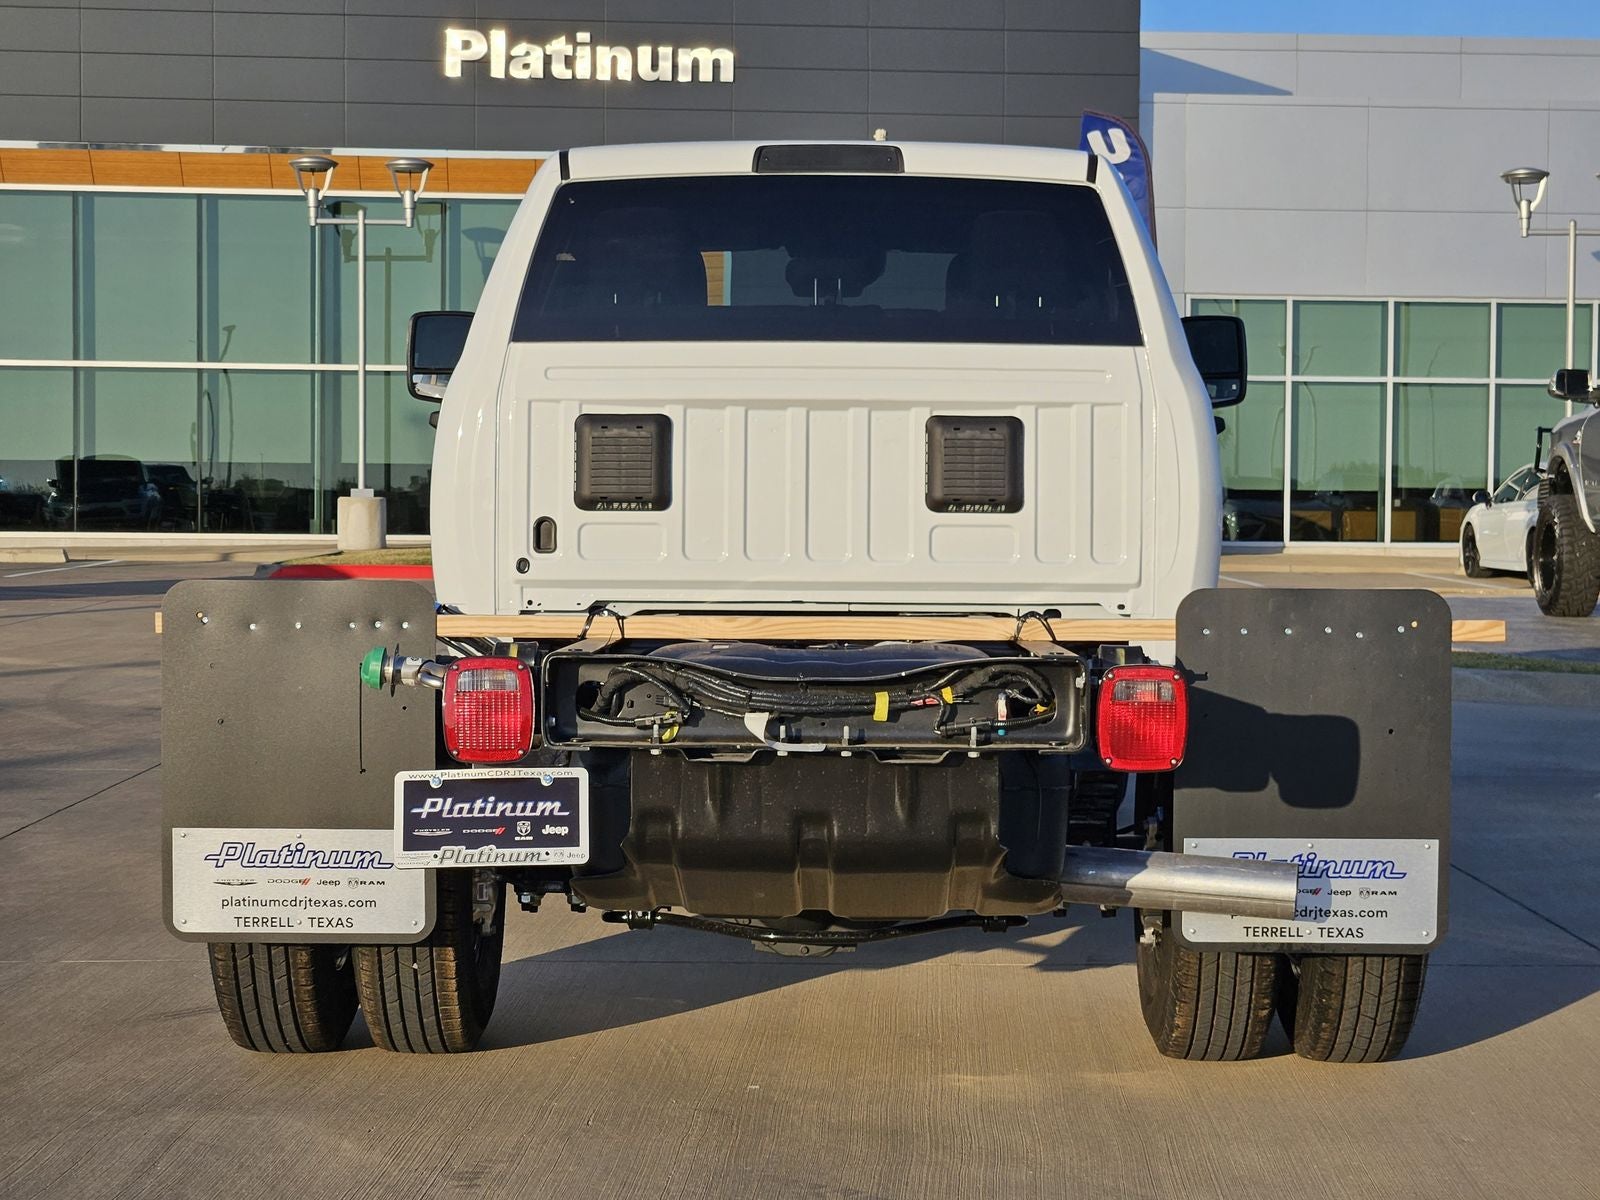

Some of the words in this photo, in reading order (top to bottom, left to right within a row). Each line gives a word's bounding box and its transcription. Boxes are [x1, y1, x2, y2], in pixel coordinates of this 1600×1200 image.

[444, 28, 734, 82] Platinum
[409, 769, 573, 779] wwwPlatinumCDRJTexascom
[410, 796, 570, 818] Platinum
[542, 824, 569, 836] Jeep
[204, 841, 394, 869] Platinum
[438, 848, 547, 864] Platinum
[1232, 851, 1407, 879] tinum
[316, 879, 341, 888] Jeep
[1327, 889, 1352, 897] Jeep
[221, 896, 377, 909] platinumcdrjtexas.com
[1231, 906, 1388, 920] cdrjtexas.com
[234, 916, 294, 928] TERRELL
[308, 917, 354, 928] TEXAS
[1243, 926, 1303, 938] TERRELL
[1317, 927, 1364, 938] TEXAS
